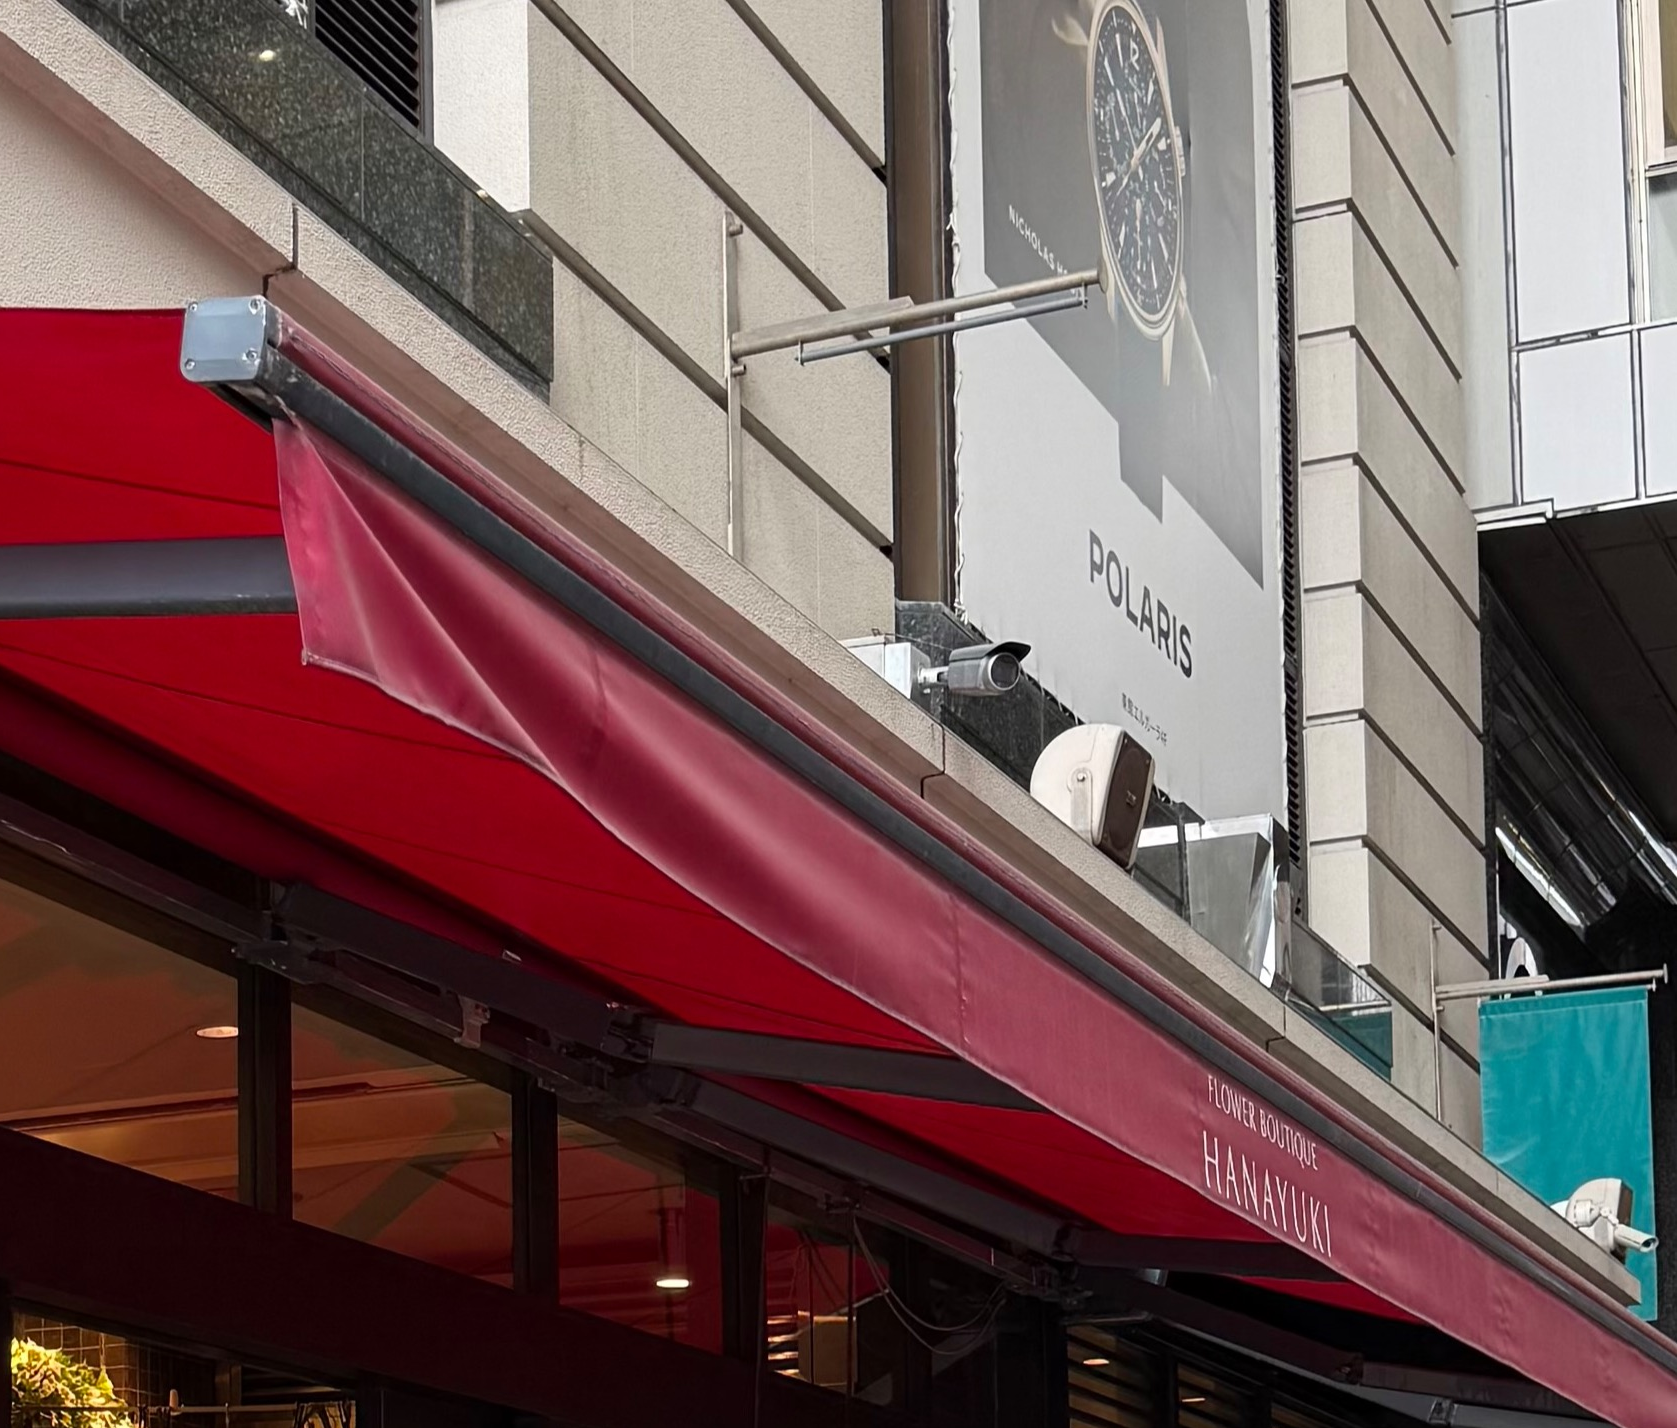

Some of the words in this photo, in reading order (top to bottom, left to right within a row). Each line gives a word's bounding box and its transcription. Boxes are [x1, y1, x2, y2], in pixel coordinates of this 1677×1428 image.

[1008, 203, 1055, 271] NICHOLAS
[1088, 528, 1193, 679] POLARIS
[1207, 1074, 1257, 1132] FLOWER
[1259, 1108, 1319, 1171] BOUTIQUE
[1202, 1130, 1332, 1259] HANAYUKI
